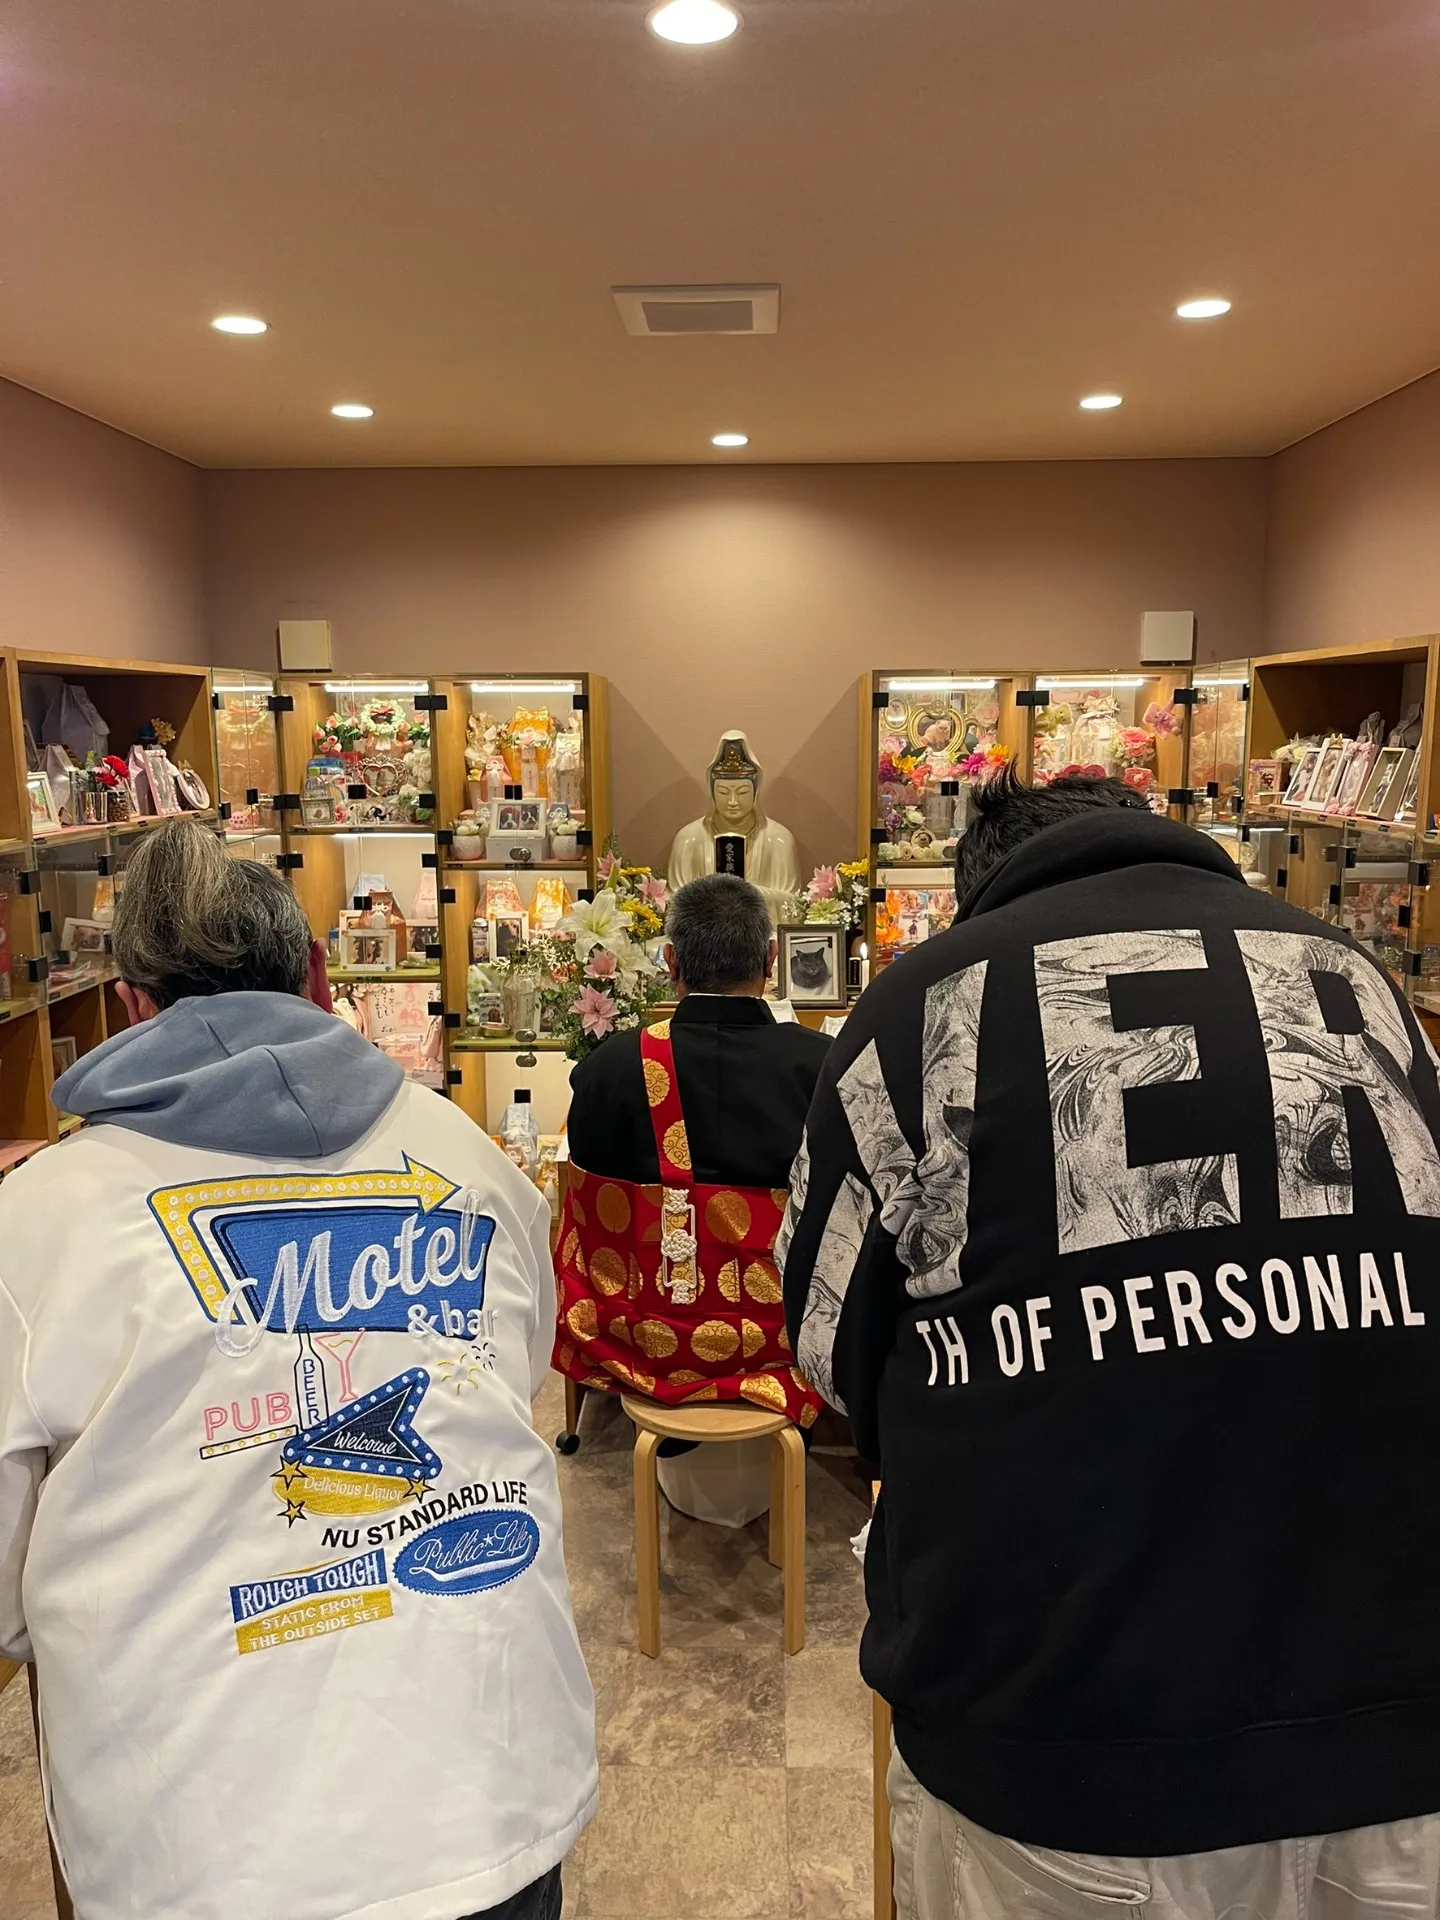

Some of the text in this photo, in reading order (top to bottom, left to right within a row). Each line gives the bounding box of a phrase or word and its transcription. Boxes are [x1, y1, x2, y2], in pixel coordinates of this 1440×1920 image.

[774, 928, 1440, 1416] VER
[214, 1189, 487, 1358] Motel
[407, 1299, 499, 1339] & bar
[991, 1296, 1054, 1378] OF
[1080, 1251, 1426, 1362] PERSONAL
[204, 1392, 292, 1441] PUB
[303, 1358, 325, 1427] BEER
[333, 1431, 397, 1455] Welcome
[304, 1476, 362, 1495] Delicious
[321, 1481, 528, 1549] NU STANDARD LIFE
[413, 1529, 484, 1570] Public
[238, 1551, 381, 1619] ROUGH TOUGH
[248, 1606, 381, 1651] THE OUTSIDE SET
[261, 1594, 365, 1631] STATIC FROM
